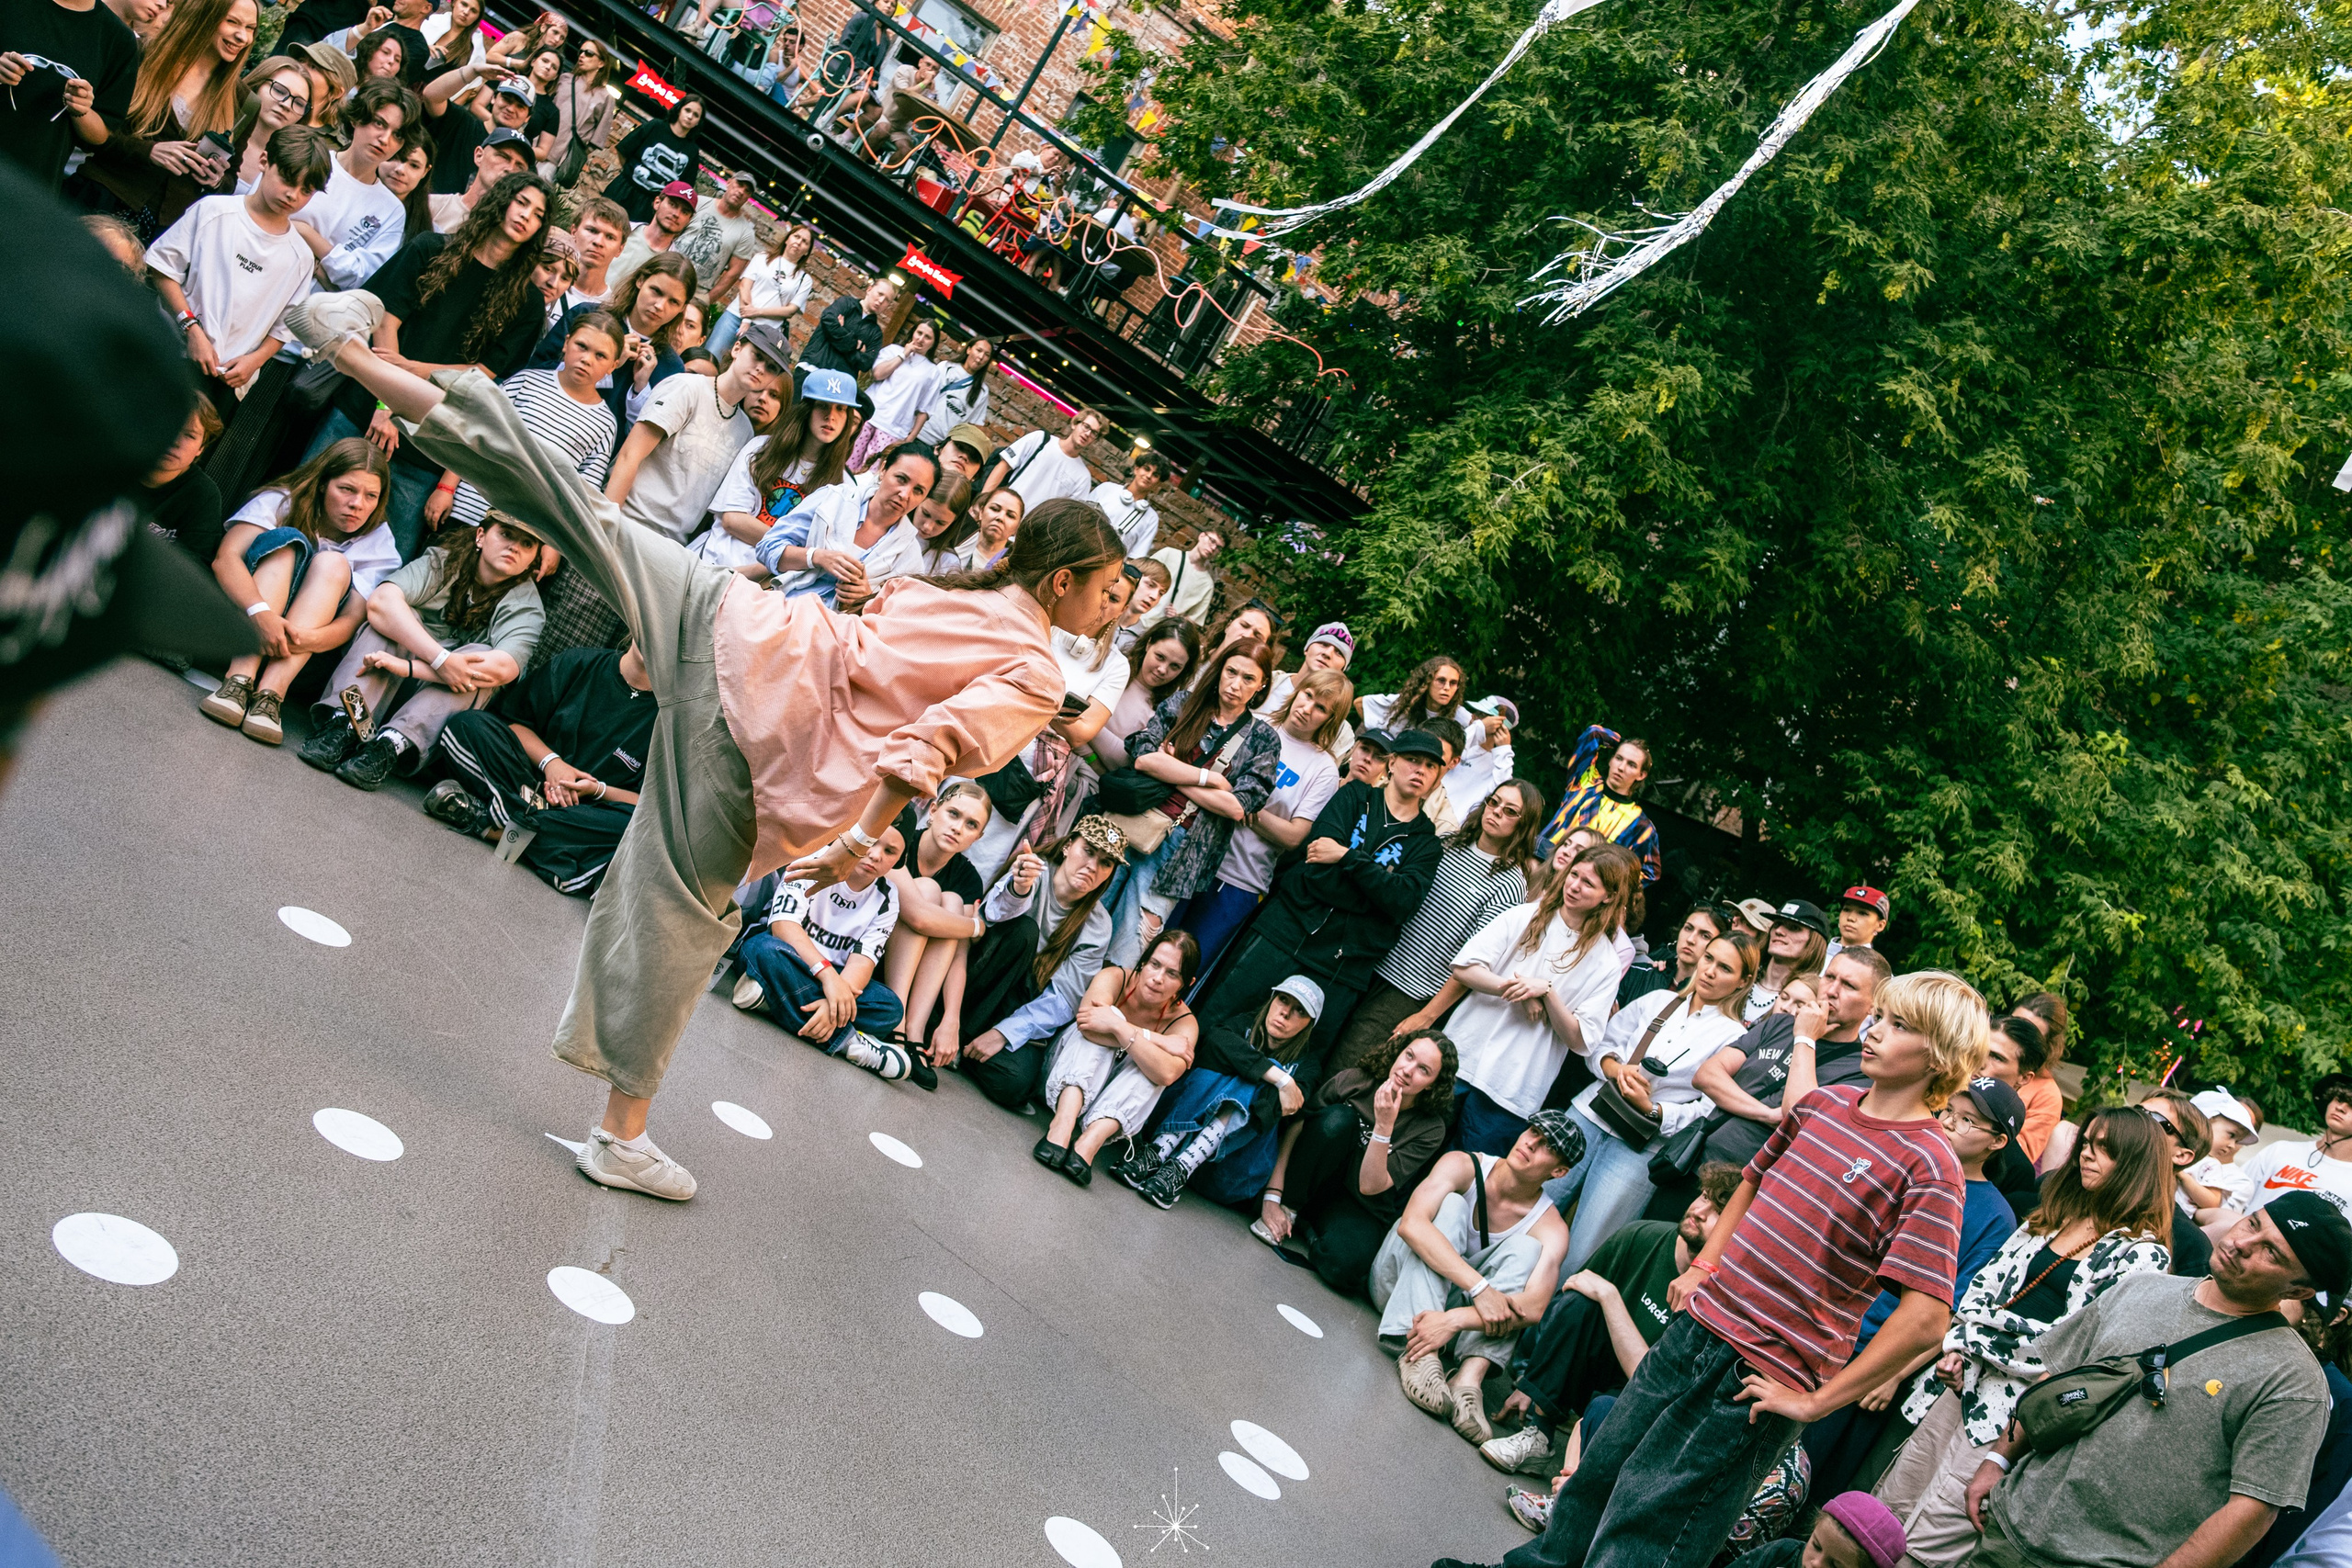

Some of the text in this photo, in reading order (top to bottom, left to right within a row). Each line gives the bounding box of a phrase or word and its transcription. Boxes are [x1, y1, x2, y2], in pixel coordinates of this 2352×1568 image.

[235, 253, 264, 273] FIND YOUR
[239, 262, 254, 274] PLACE
[826, 377, 842, 394] NY
[1758, 1048, 1784, 1060] NEW
[2274, 1164, 2319, 1186] NIKE
